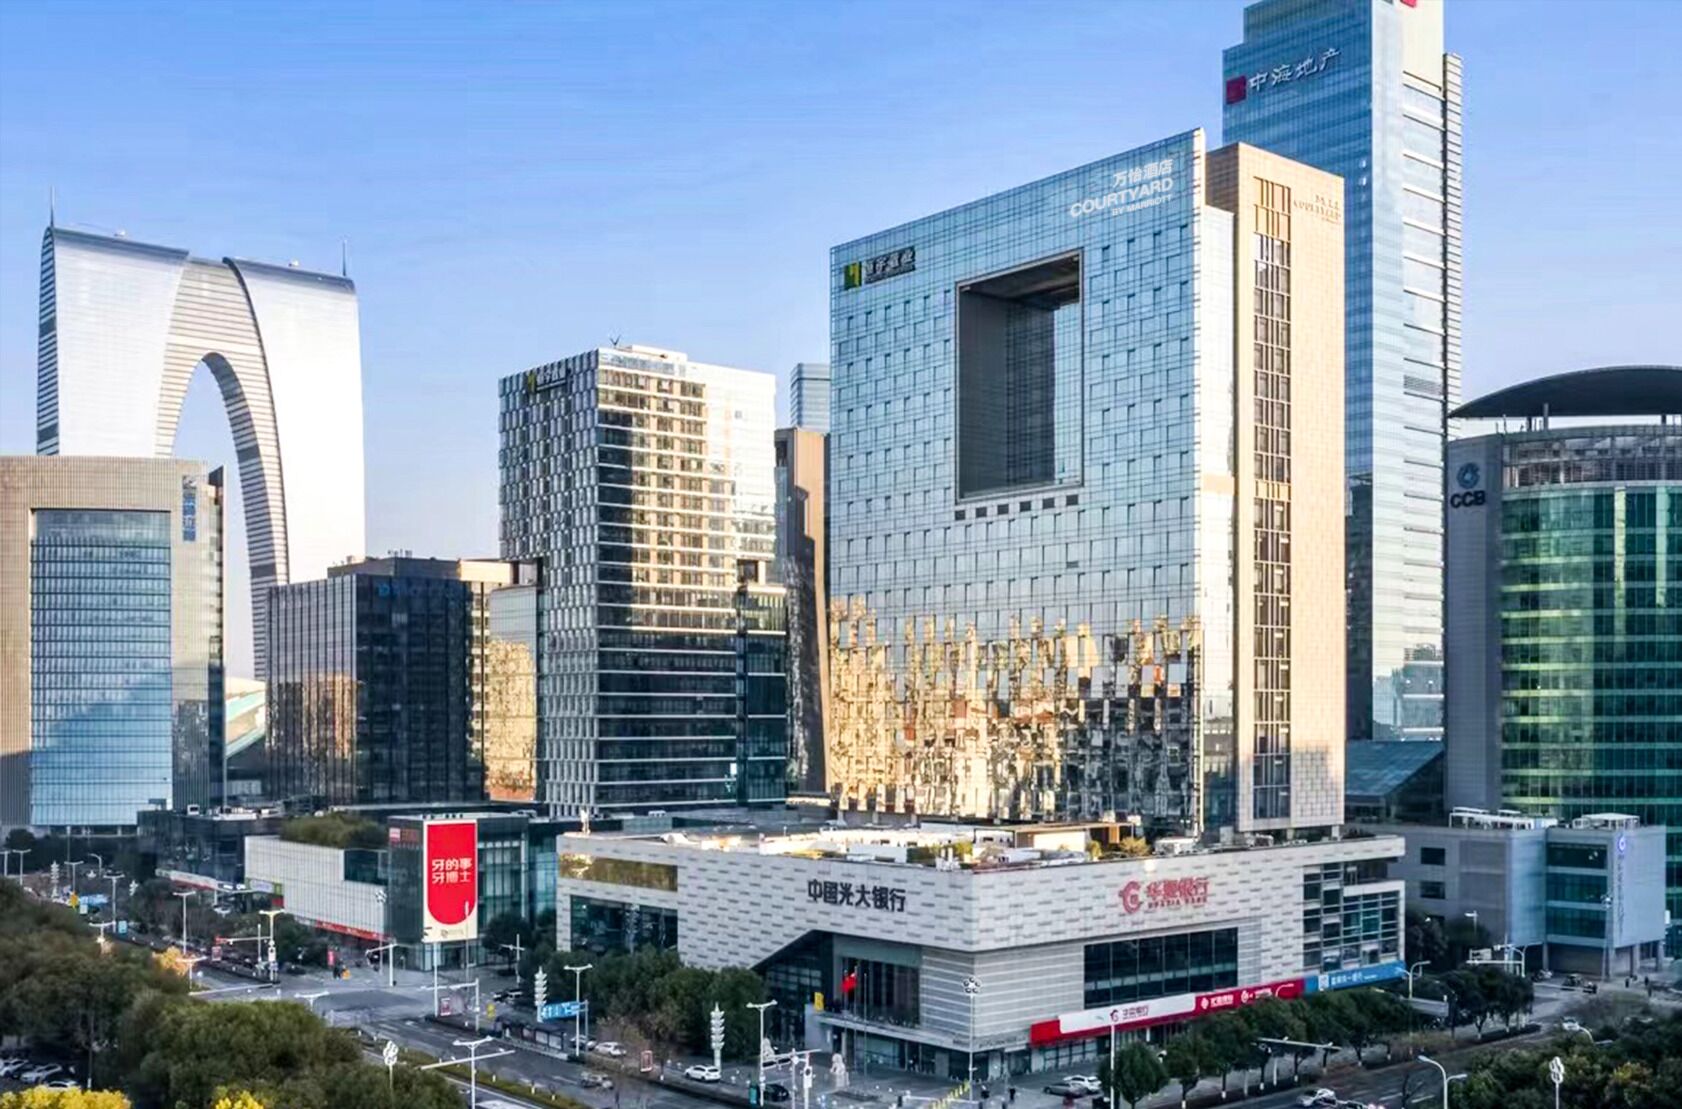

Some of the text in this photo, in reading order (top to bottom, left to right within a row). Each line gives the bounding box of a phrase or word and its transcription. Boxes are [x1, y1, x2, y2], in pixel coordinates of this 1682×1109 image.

[1249, 48, 1340, 91] 中海地产
[1112, 158, 1174, 189] 万怡酒店
[1069, 177, 1174, 218] COURTYARD
[1450, 490, 1487, 508] CCB
[807, 878, 907, 912] 中国光大银行
